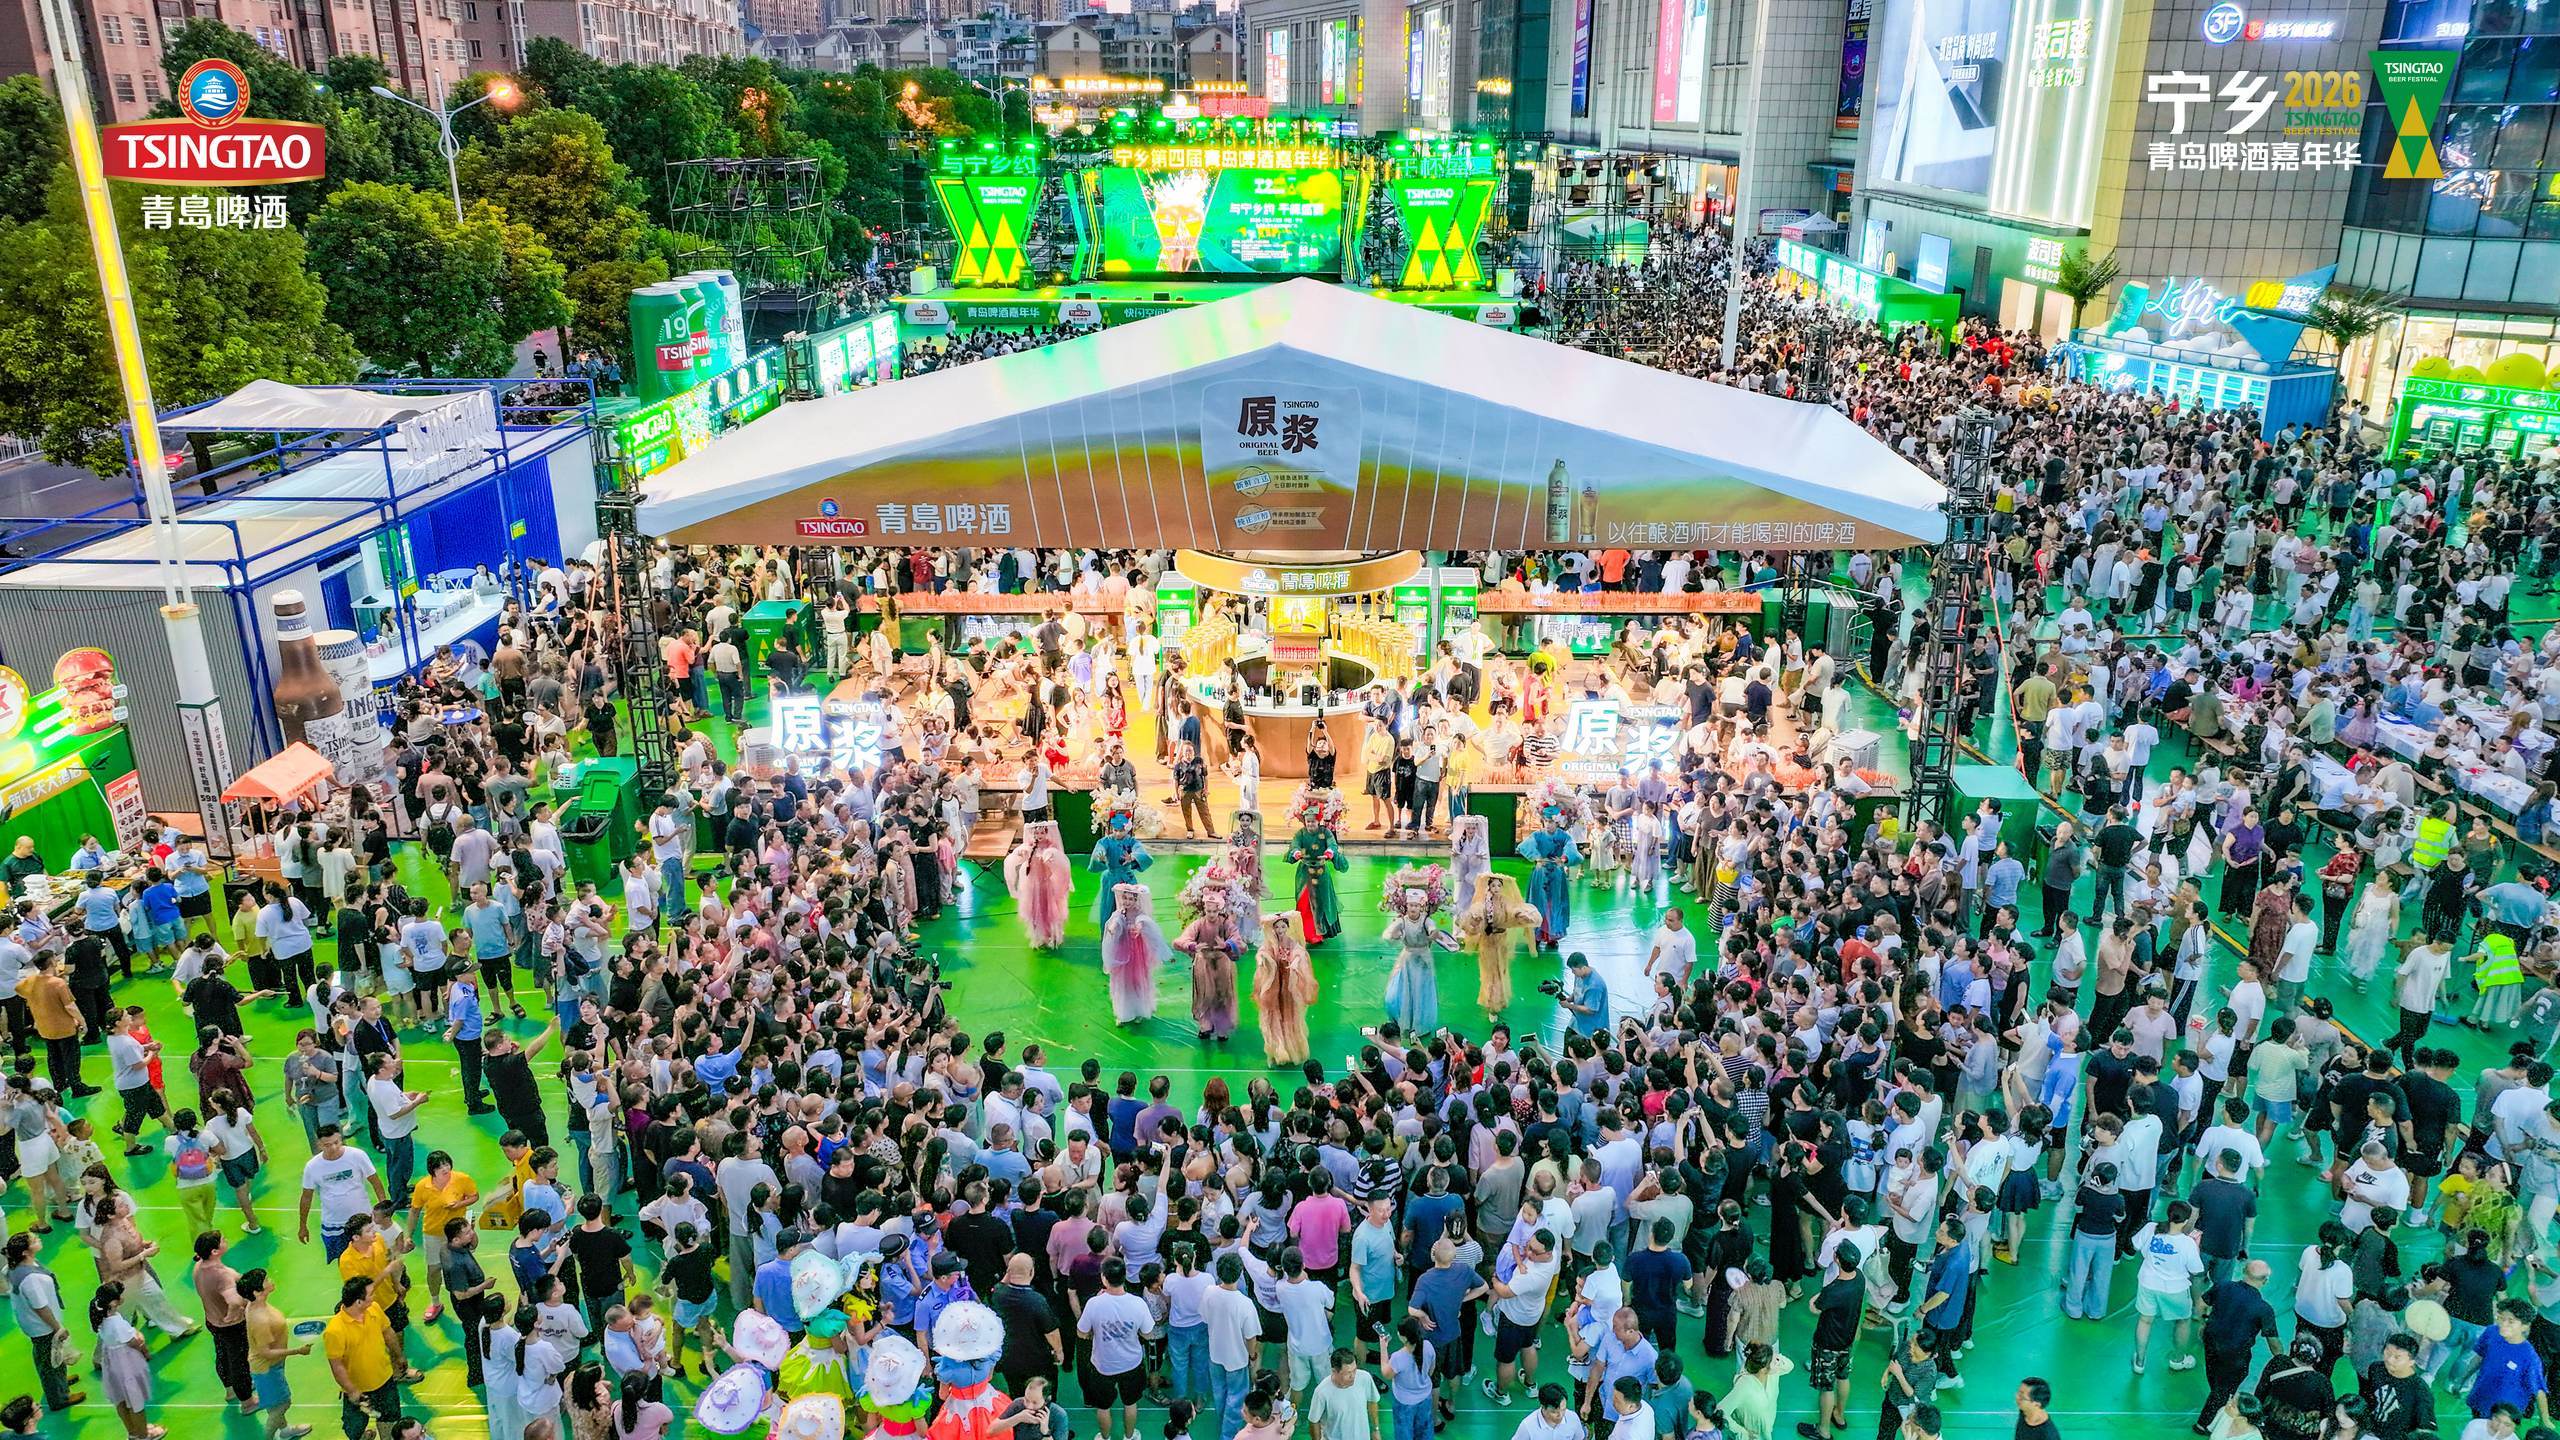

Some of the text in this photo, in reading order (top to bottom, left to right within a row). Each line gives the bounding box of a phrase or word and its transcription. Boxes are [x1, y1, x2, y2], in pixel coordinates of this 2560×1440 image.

[1115, 148, 1329, 168] 宁乡第四届青岛啤酒嘉年华
[941, 155, 1036, 175] 与宁乡约
[979, 186, 1027, 197] TSINGTAO
[1406, 188, 1454, 199] TSINGTAO
[967, 307, 1040, 318] 青岛啤酒嘉年华
[1282, 400, 1319, 408] TSINGTAO
[1237, 395, 1319, 454] 原浆
[1239, 441, 1279, 449] ORIGINAL
[876, 502, 1012, 534] 青島啤酒
[801, 521, 865, 534] TSINGTAO
[1608, 521, 1856, 545] 以往酿酒师才能喝到的啤酒
[1282, 571, 1351, 591] 青島啤酒
[829, 703, 881, 713] TSINGTAO
[1629, 706, 1681, 717] TSINGTAO
[770, 695, 882, 769] 原浆
[1562, 762, 1620, 772] ORIGINAL
[2360, 1171, 2377, 1183] NIKE
